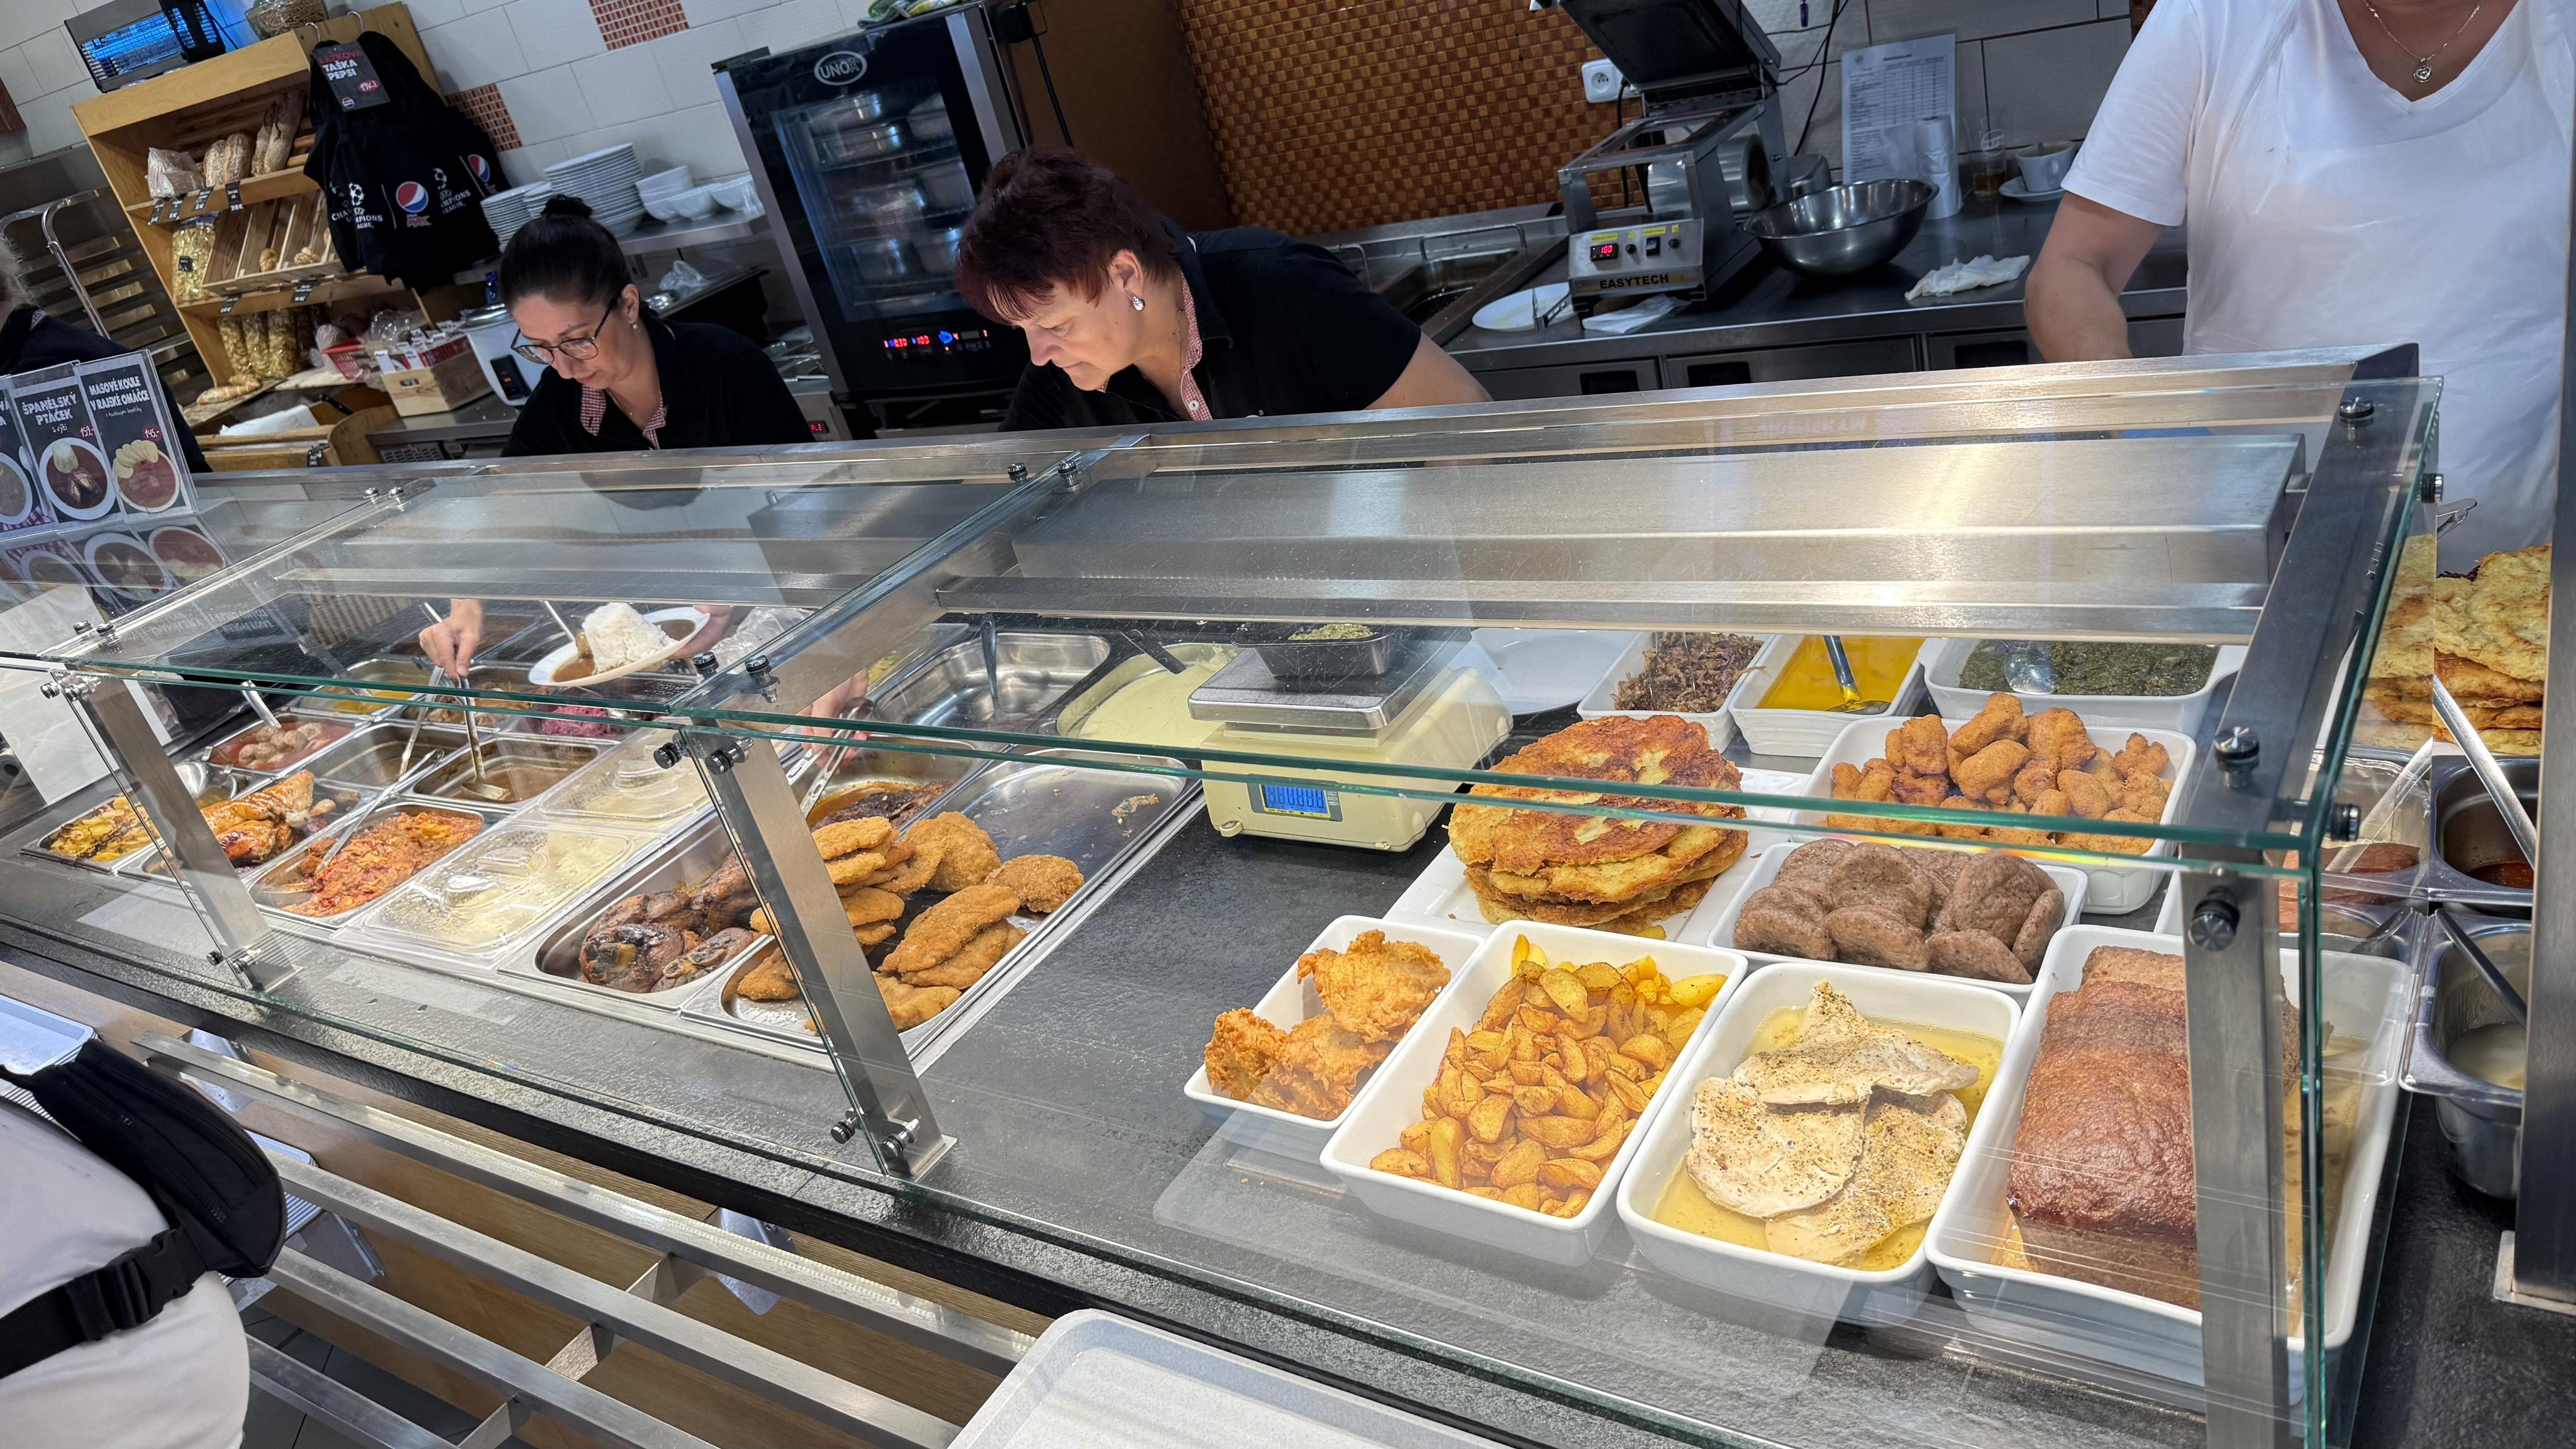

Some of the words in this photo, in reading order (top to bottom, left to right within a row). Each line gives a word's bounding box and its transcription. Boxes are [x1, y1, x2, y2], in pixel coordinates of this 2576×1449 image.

[323, 59, 357, 72] TAŠKA
[327, 68, 357, 80] PEPSI
[819, 57, 860, 79] UNOX
[1599, 274, 1669, 289] EASYTECH
[89, 378, 119, 396] MASOVÉ
[118, 376, 142, 390] KOULE
[21, 391, 77, 415] ŠPANĚLSKÝ
[89, 400, 96, 411] V
[96, 393, 121, 409] RAJSKÉ
[121, 388, 150, 405] OMÁČCE
[35, 408, 73, 426] PTÁČEK
